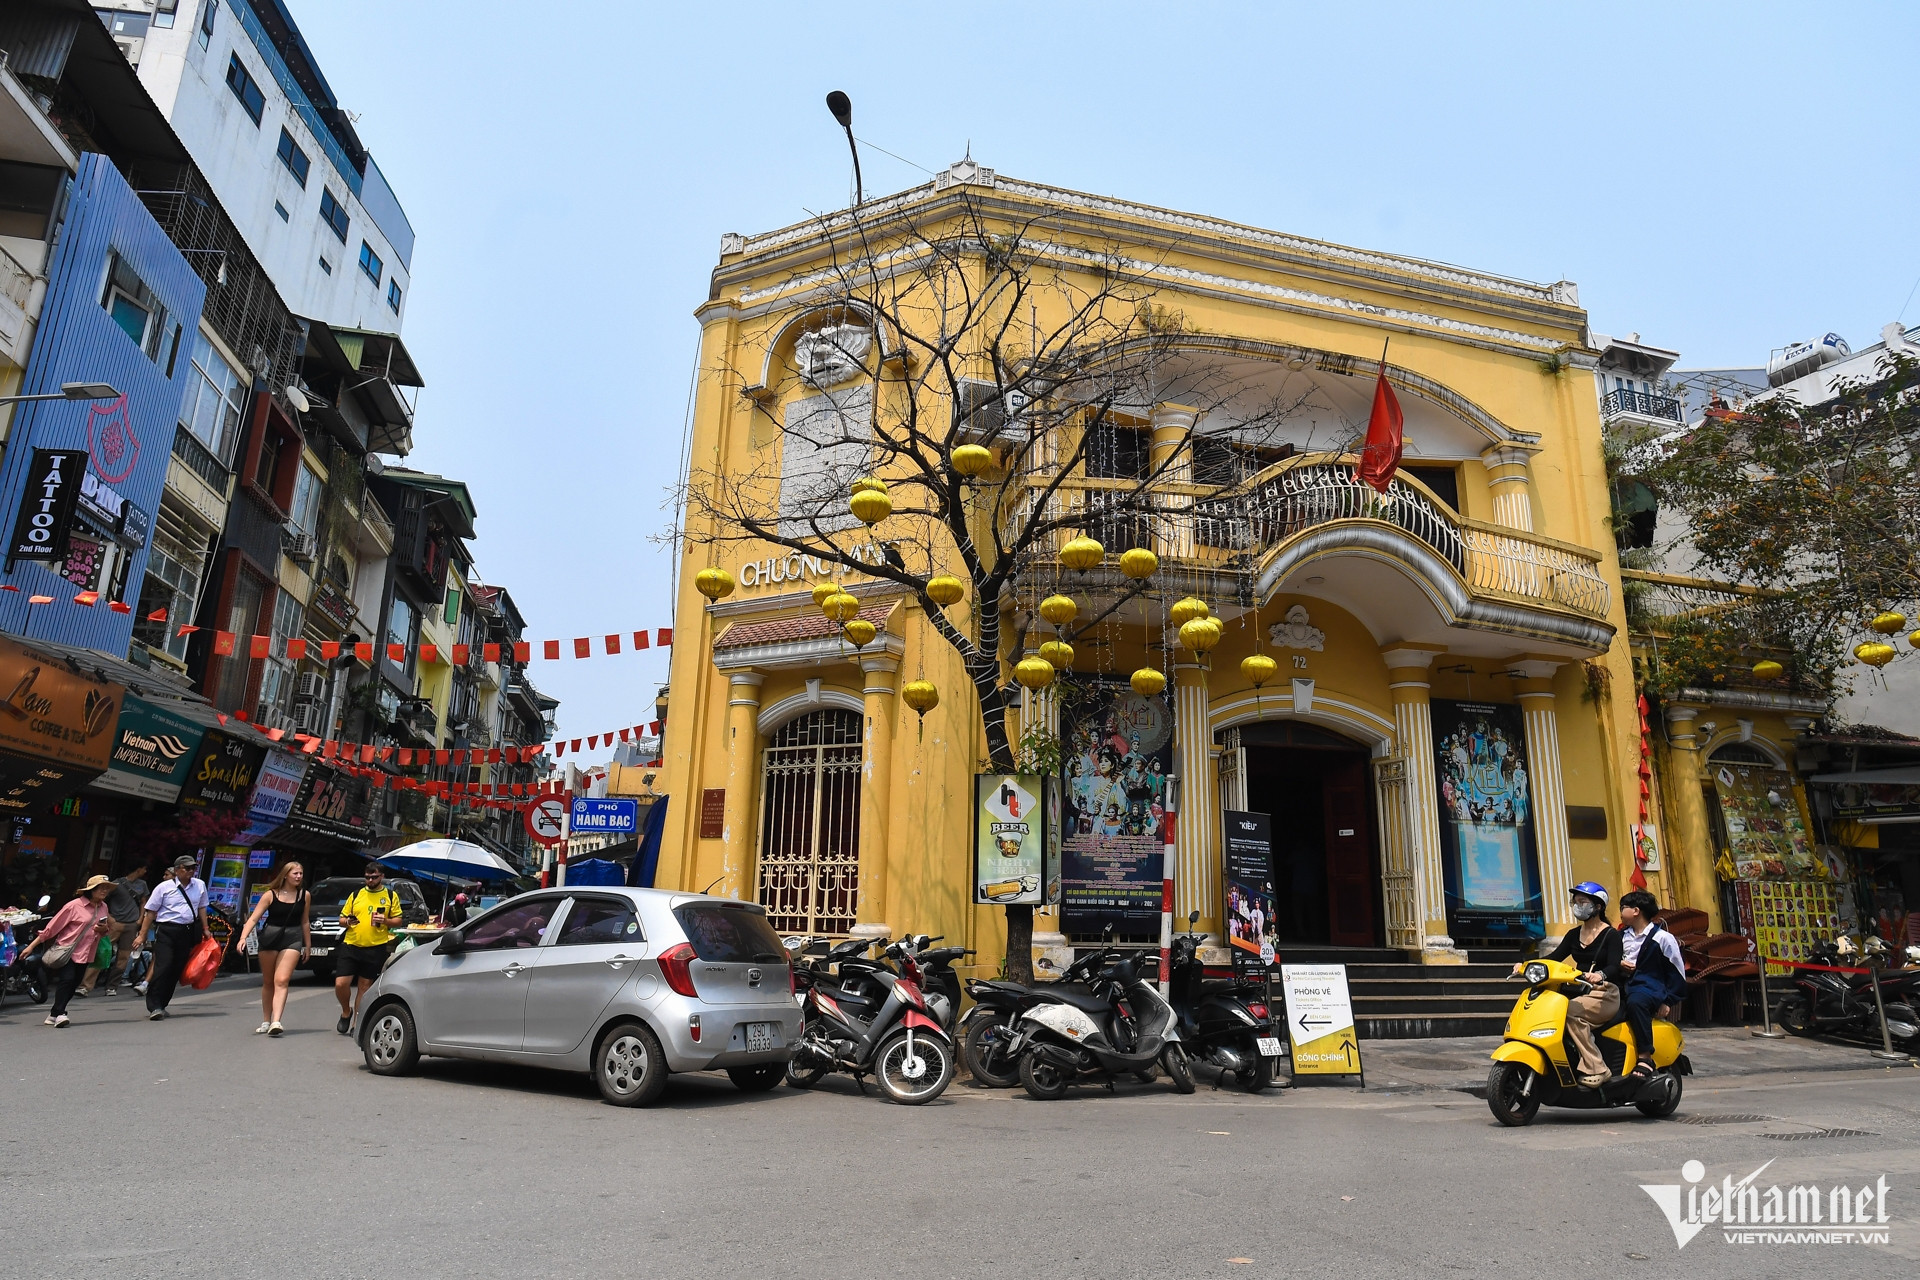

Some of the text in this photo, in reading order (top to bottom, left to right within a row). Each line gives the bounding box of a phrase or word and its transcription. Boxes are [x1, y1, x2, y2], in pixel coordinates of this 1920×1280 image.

[28, 455, 67, 543] TATTOO
[128, 505, 148, 527] TATTOO
[19, 545, 53, 553] 2nd Floor
[1293, 655, 1306, 668] 72
[30, 718, 63, 740] COFFEE
[122, 729, 157, 753] Vietnam
[114, 747, 159, 770] IMPRESSIVE
[157, 762, 176, 774] travel
[197, 754, 225, 784] Spa
[229, 761, 252, 791] Nail
[598, 801, 618, 811] PHỐ
[576, 811, 630, 829] HÀNG BẠC
[992, 823, 1029, 834] BEER
[988, 859, 1033, 867] NIGHT
[368, 906, 373, 914] 9
[1294, 987, 1320, 996] PHÒNG
[1321, 1052, 1345, 1062] CHÍNH
